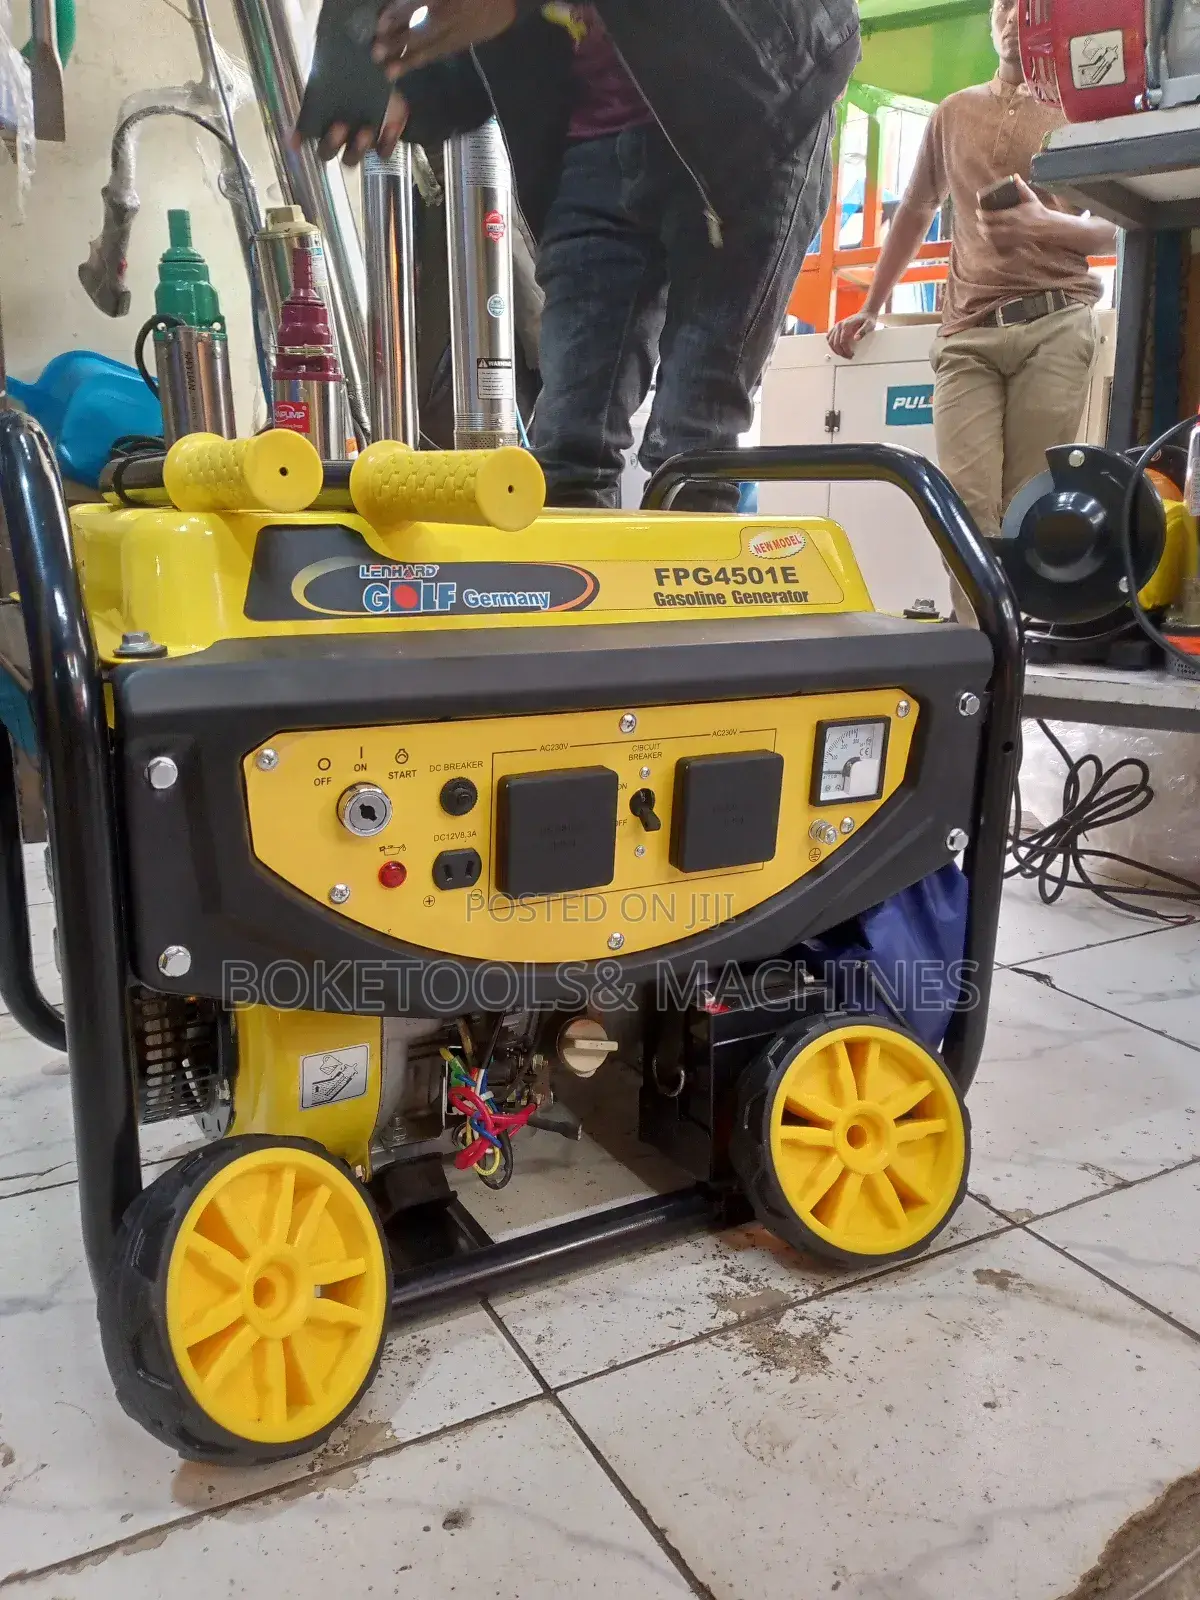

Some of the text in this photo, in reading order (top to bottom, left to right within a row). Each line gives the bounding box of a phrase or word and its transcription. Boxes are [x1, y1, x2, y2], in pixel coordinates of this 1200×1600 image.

[753, 534, 802, 555] NEW MODEL
[359, 565, 439, 579] LENHARD
[654, 566, 800, 587] FPG4501E
[363, 580, 551, 614] GOLF Germany
[653, 589, 810, 607] Gasoline Generator
[711, 729, 738, 738] AC230V
[539, 743, 569, 752] AC230V
[628, 751, 663, 761] BREAKER
[353, 763, 368, 772] ON
[429, 760, 484, 773] DC BREAKER
[388, 769, 418, 780] START
[313, 777, 333, 787] OFF
[433, 830, 477, 842] DC12V8.3A
